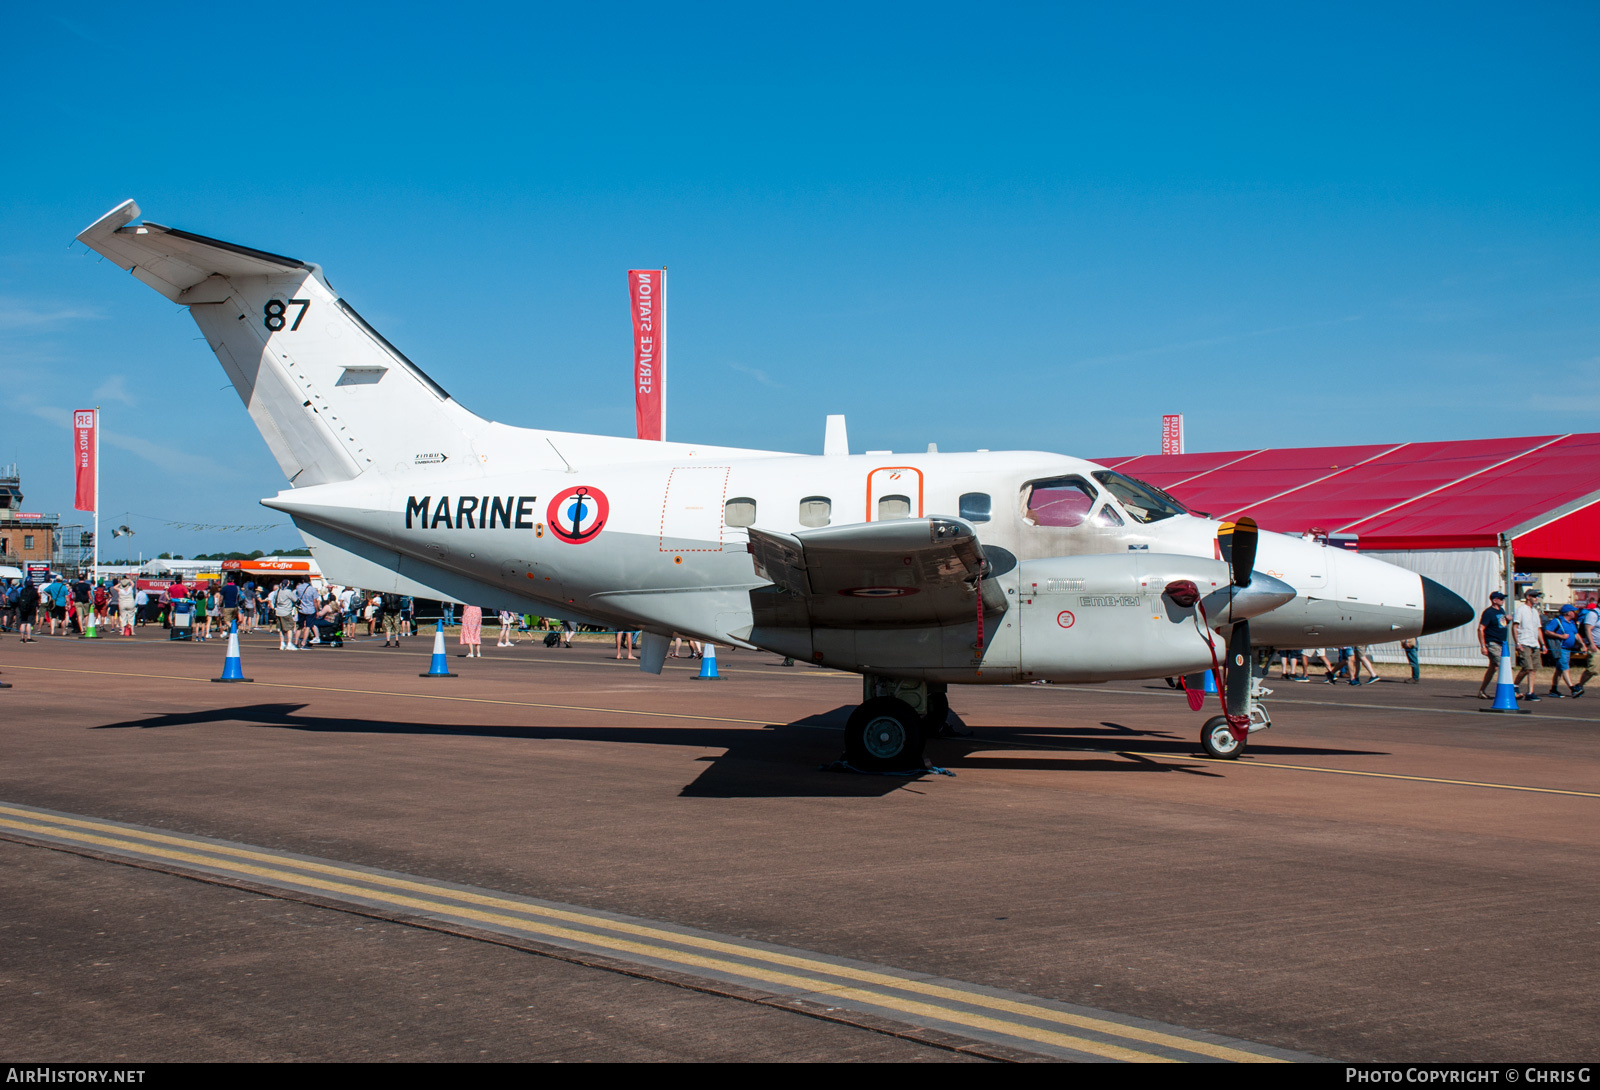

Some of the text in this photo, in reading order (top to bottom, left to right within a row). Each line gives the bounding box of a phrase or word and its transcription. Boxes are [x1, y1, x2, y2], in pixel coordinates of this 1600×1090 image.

[263, 299, 311, 332] 87
[405, 496, 537, 530] MARINE
[272, 562, 293, 570] Coffee
